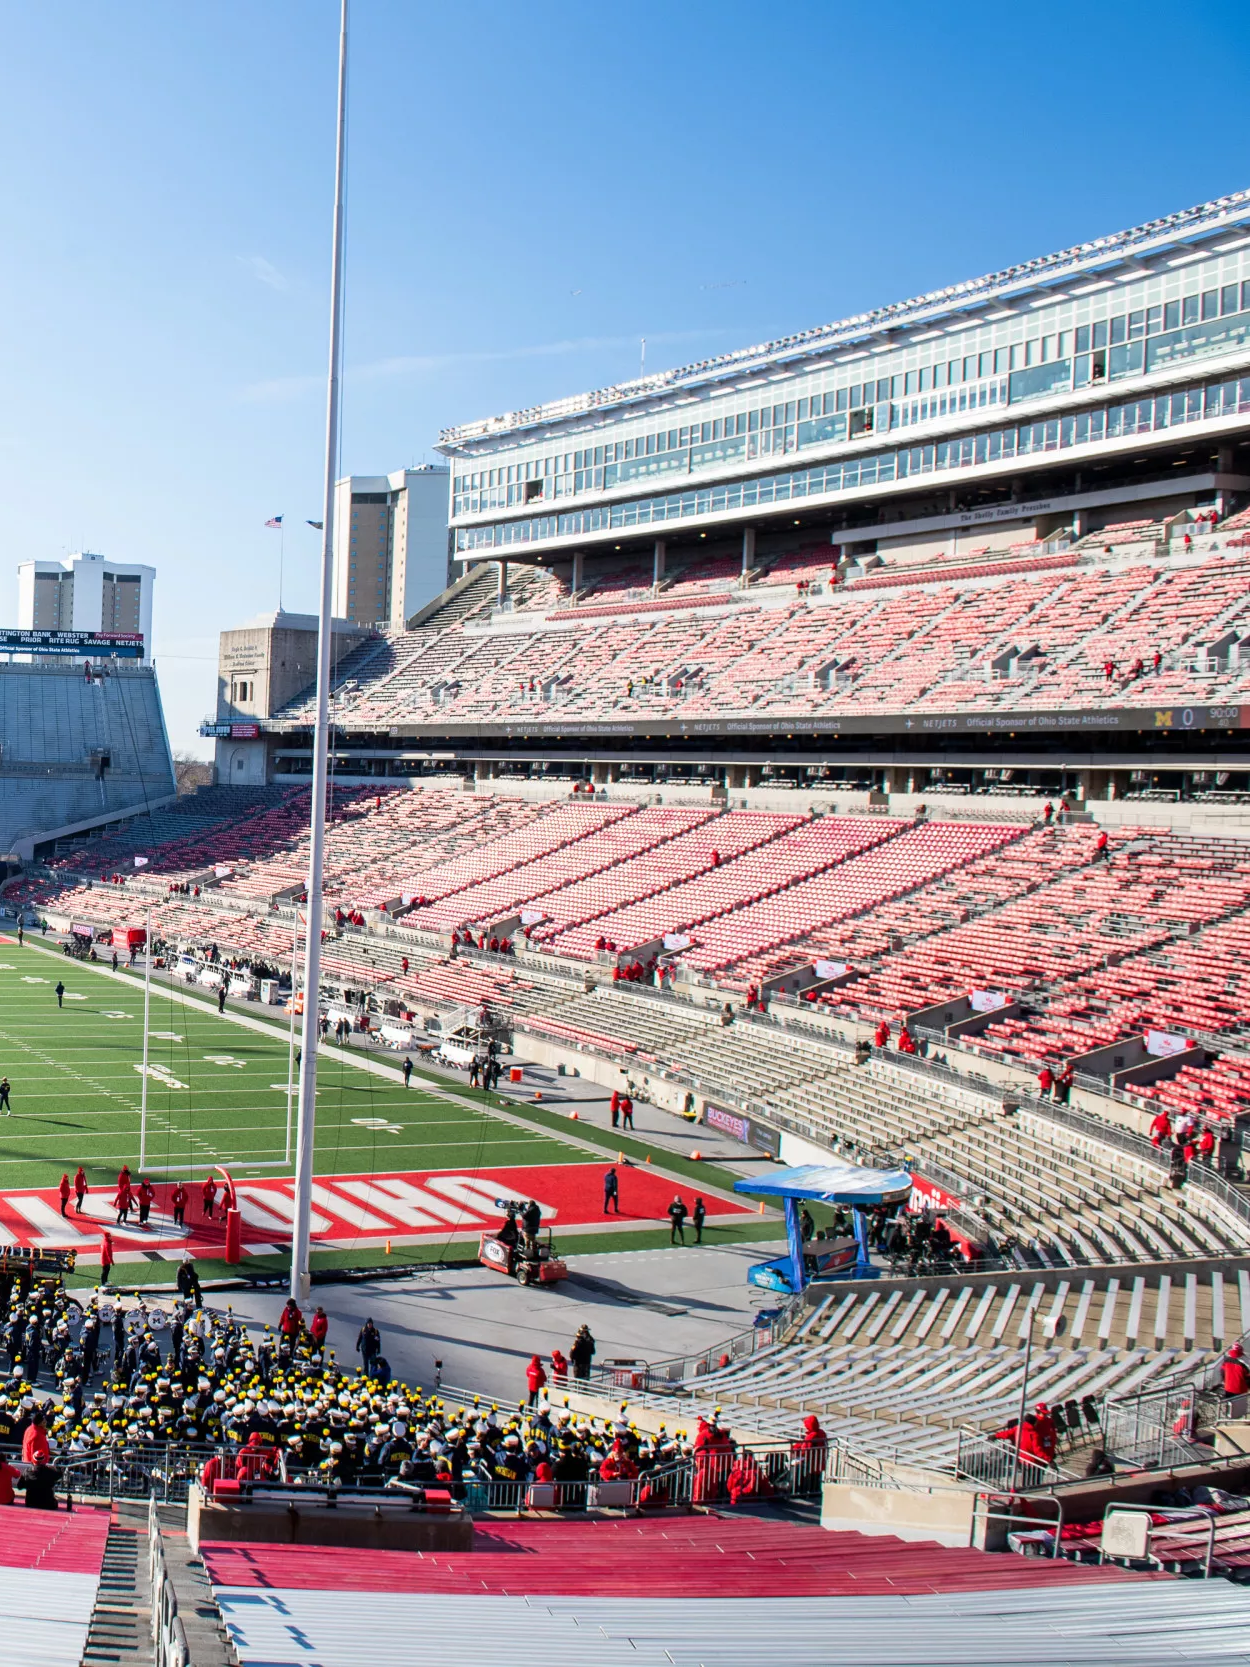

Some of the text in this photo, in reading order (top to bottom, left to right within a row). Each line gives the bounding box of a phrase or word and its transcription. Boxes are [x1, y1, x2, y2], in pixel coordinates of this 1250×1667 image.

[115, 639, 144, 647] NETJETS
[1154, 708, 1194, 727] M 0
[1210, 707, 1239, 718] 90:00
[694, 723, 720, 732] NETJETS
[726, 722, 747, 730] Official
[748, 722, 773, 732] Sponsor
[781, 722, 794, 730] Ohio
[795, 721, 812, 729] State
[812, 721, 841, 729] Athletics
[923, 715, 1119, 730] NETJETS Official Sponsor of Ohio State Athletics
[517, 726, 539, 734] NETJETS
[707, 1107, 743, 1132] BUCKEYES
